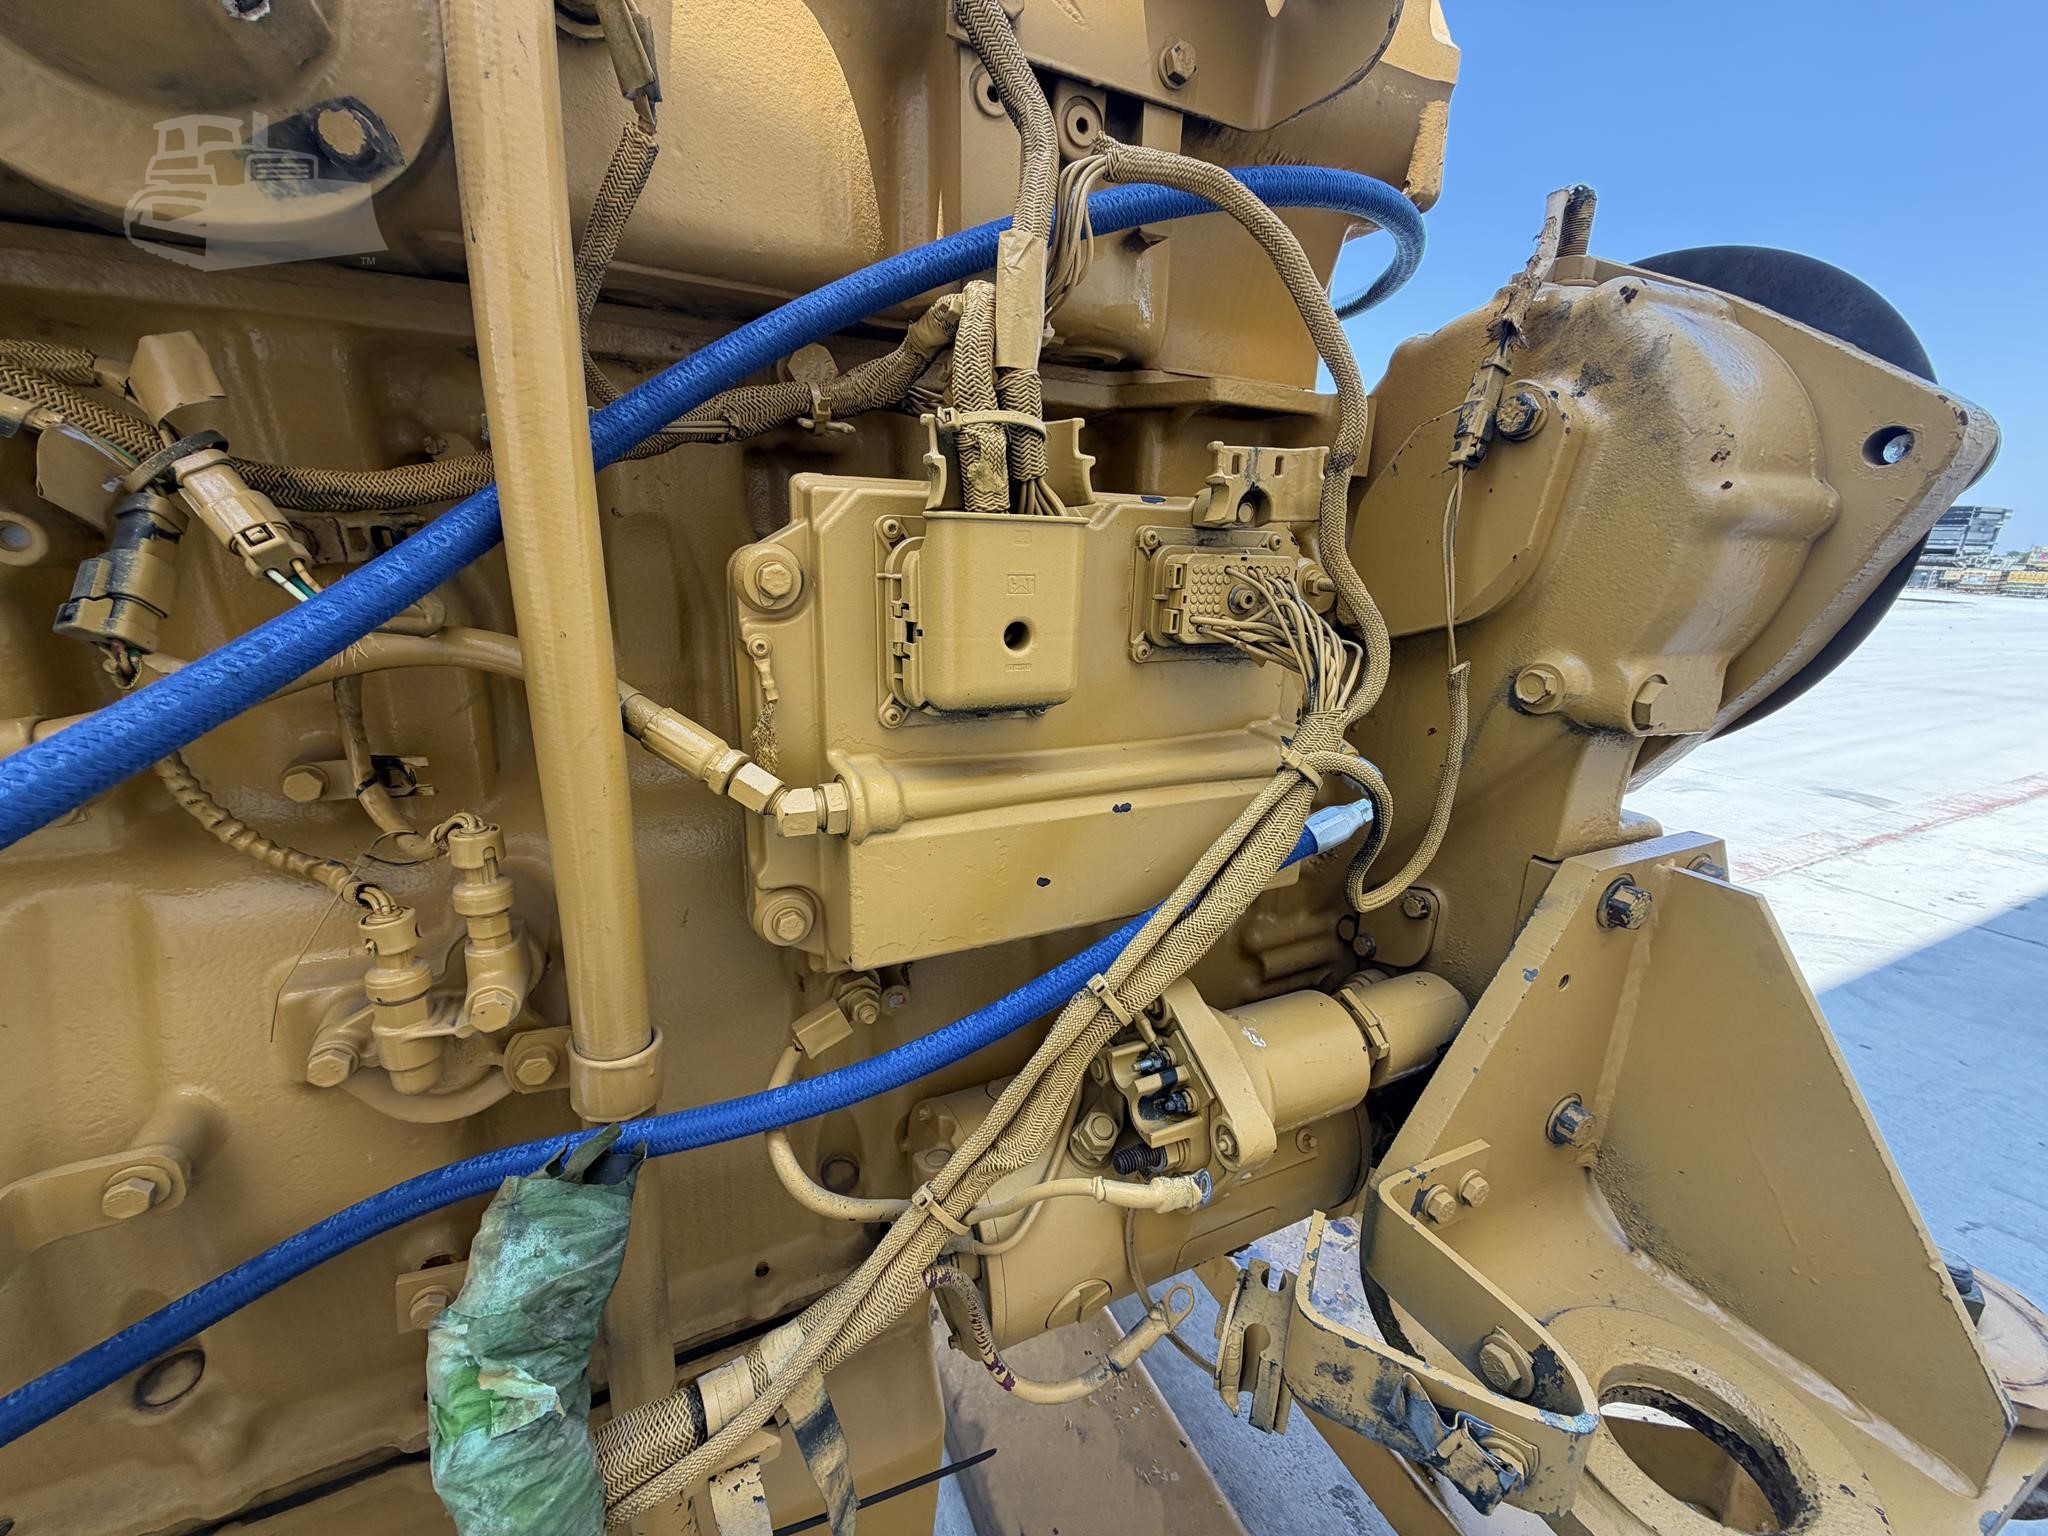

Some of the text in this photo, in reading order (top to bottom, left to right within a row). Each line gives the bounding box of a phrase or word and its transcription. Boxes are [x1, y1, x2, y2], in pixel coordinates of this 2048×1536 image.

[772, 1070, 842, 1104] EATON
[885, 1011, 979, 1063] AEROQUIP
[993, 986, 1030, 1013] AQP
